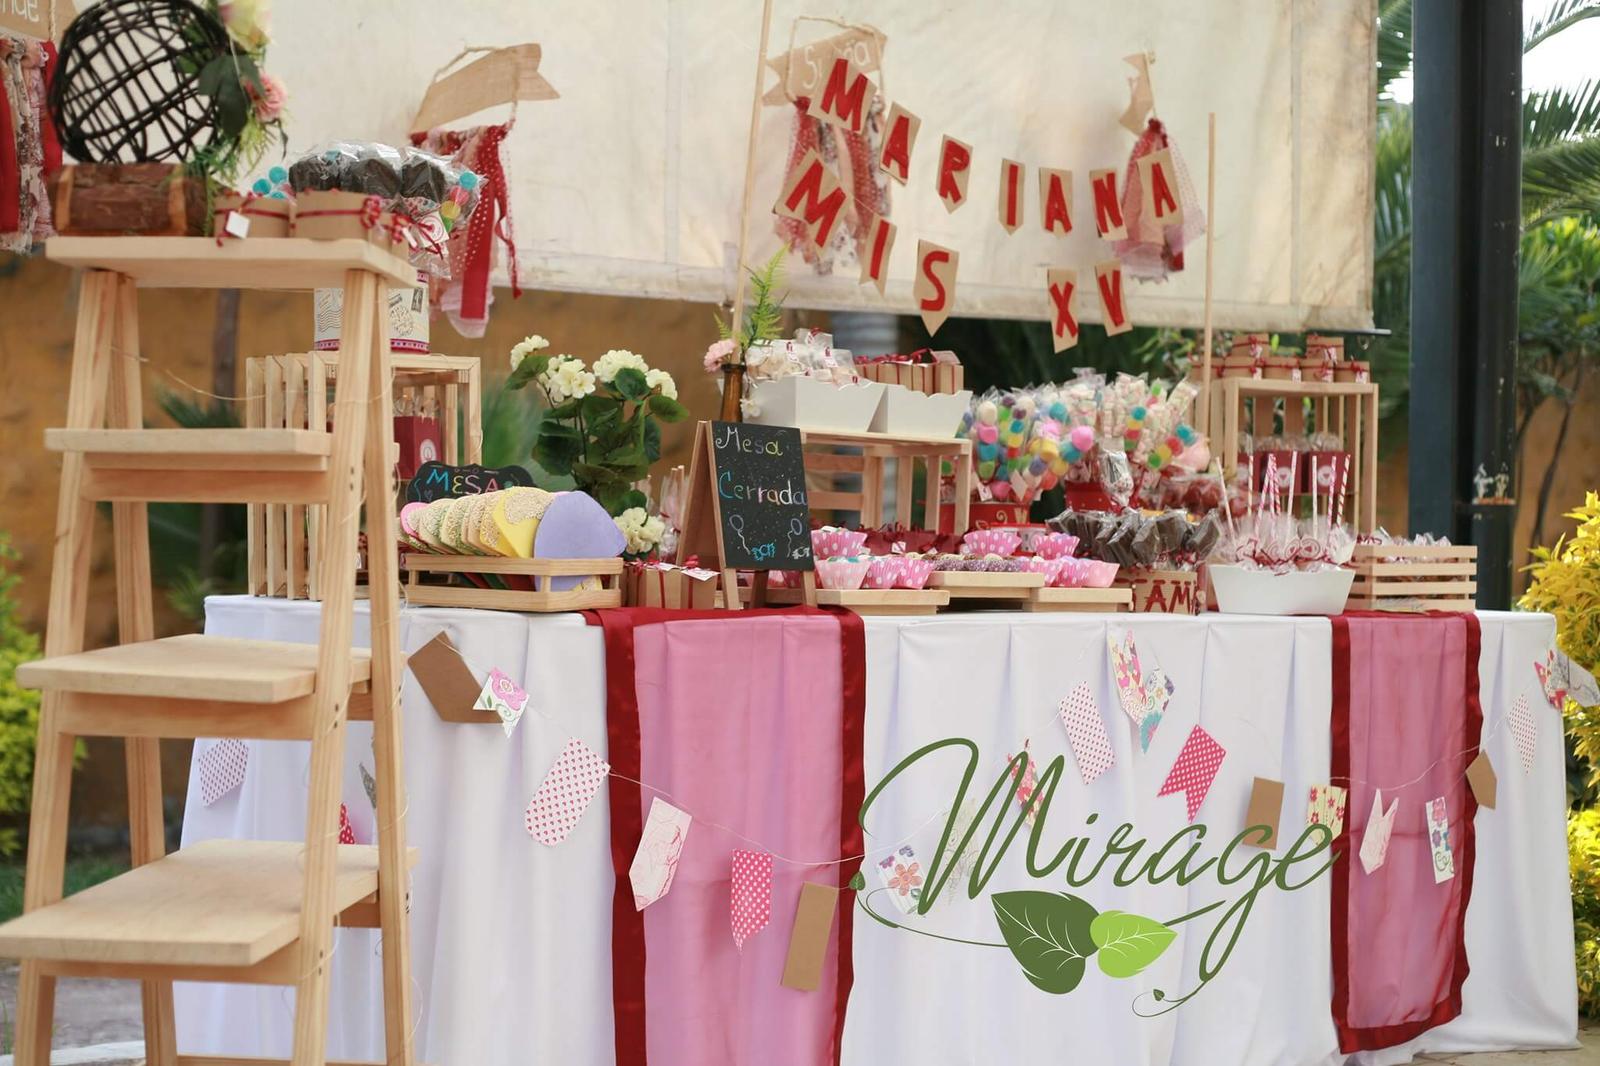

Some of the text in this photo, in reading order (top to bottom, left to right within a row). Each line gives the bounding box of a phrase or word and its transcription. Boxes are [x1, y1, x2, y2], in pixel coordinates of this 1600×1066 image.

[820, 58, 1177, 234] MARIANA
[785, 161, 1125, 338] MIS XV
[715, 425, 784, 456] Mesa
[426, 468, 499, 495] MESA
[719, 471, 808, 506] Cerrada
